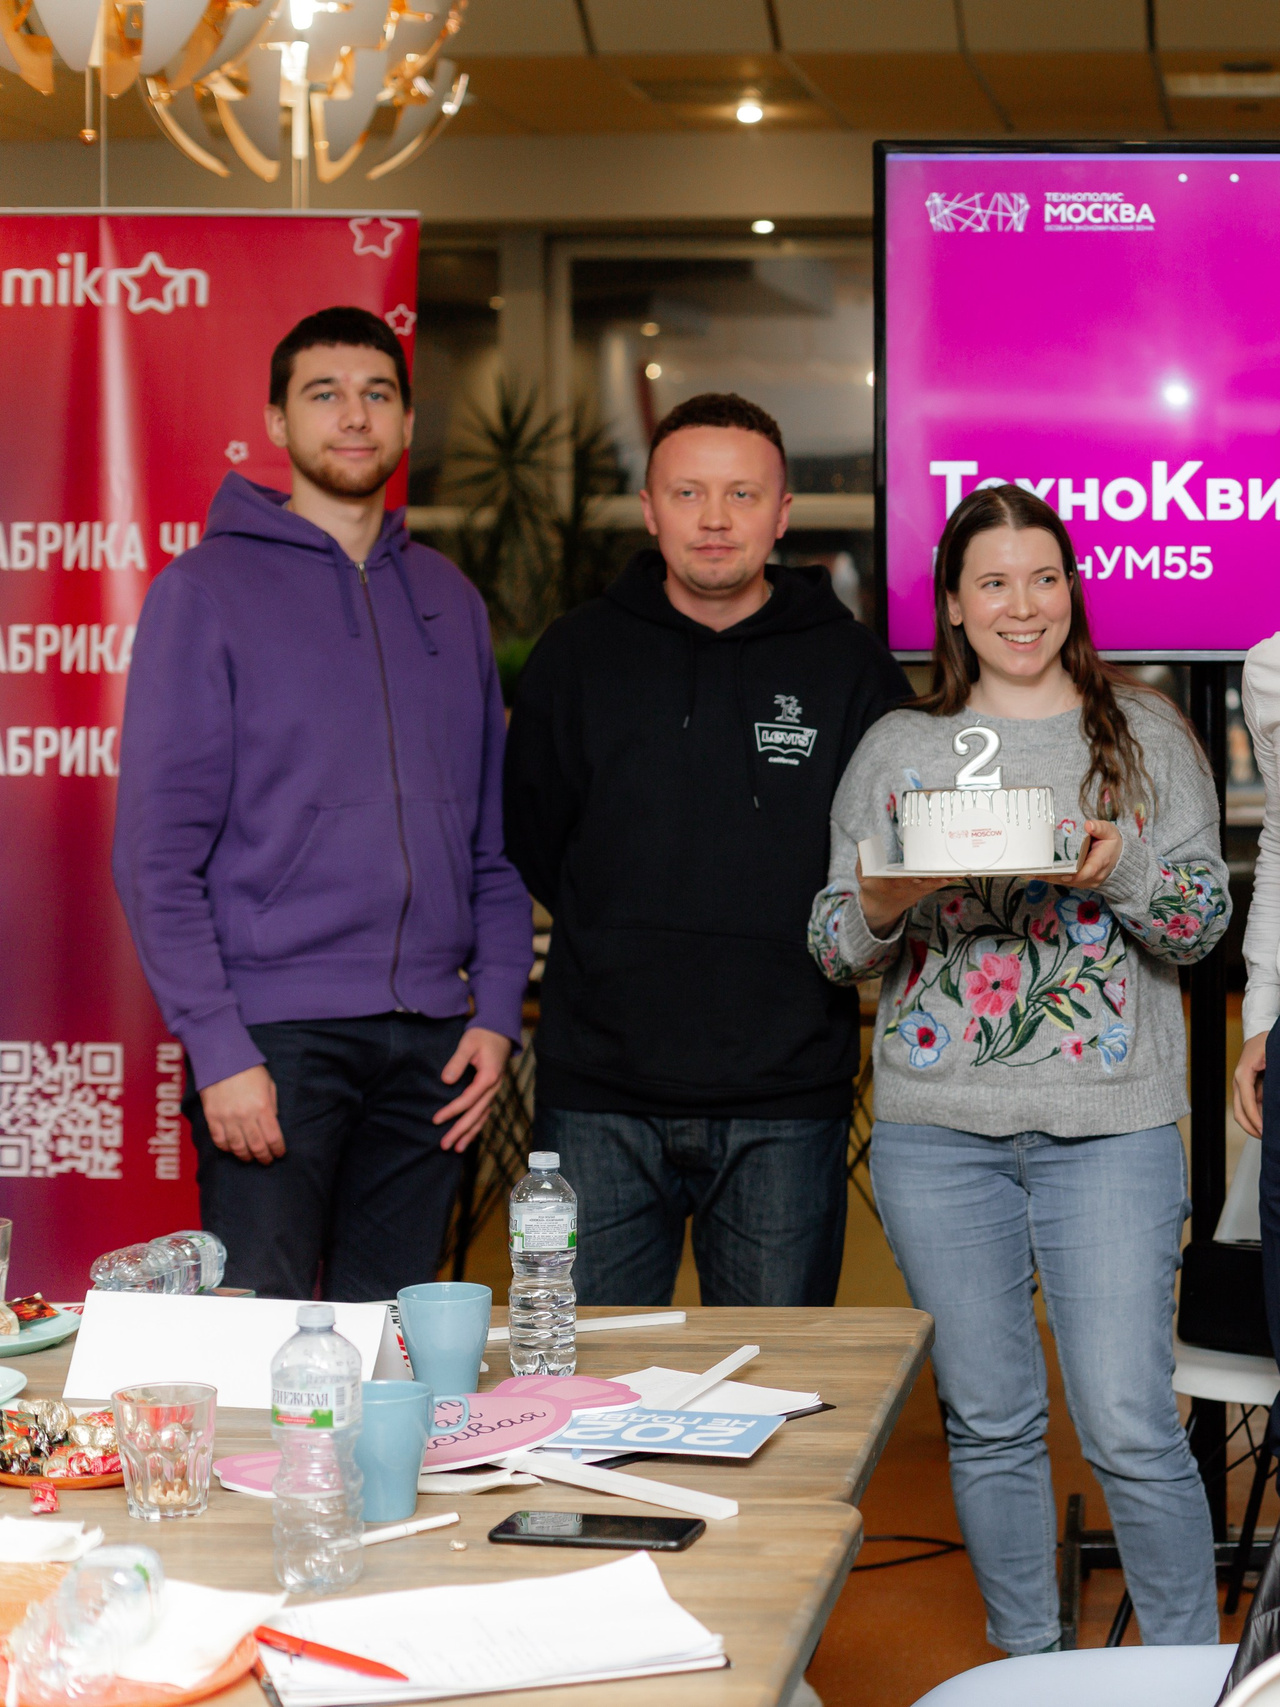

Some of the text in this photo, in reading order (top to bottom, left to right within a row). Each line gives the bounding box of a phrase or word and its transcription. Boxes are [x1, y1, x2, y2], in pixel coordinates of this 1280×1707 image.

[1044, 192, 1125, 203] ТЕХНОПОЛИС
[1044, 203, 1156, 224] МОСКВА
[0, 726, 120, 777] БРИК
[953, 726, 1002, 788] 2
[971, 830, 1002, 838] MOSCOW
[147, 1042, 182, 1180] mikron.ru
[578, 1413, 757, 1428] НЕ ПОДВЕ
